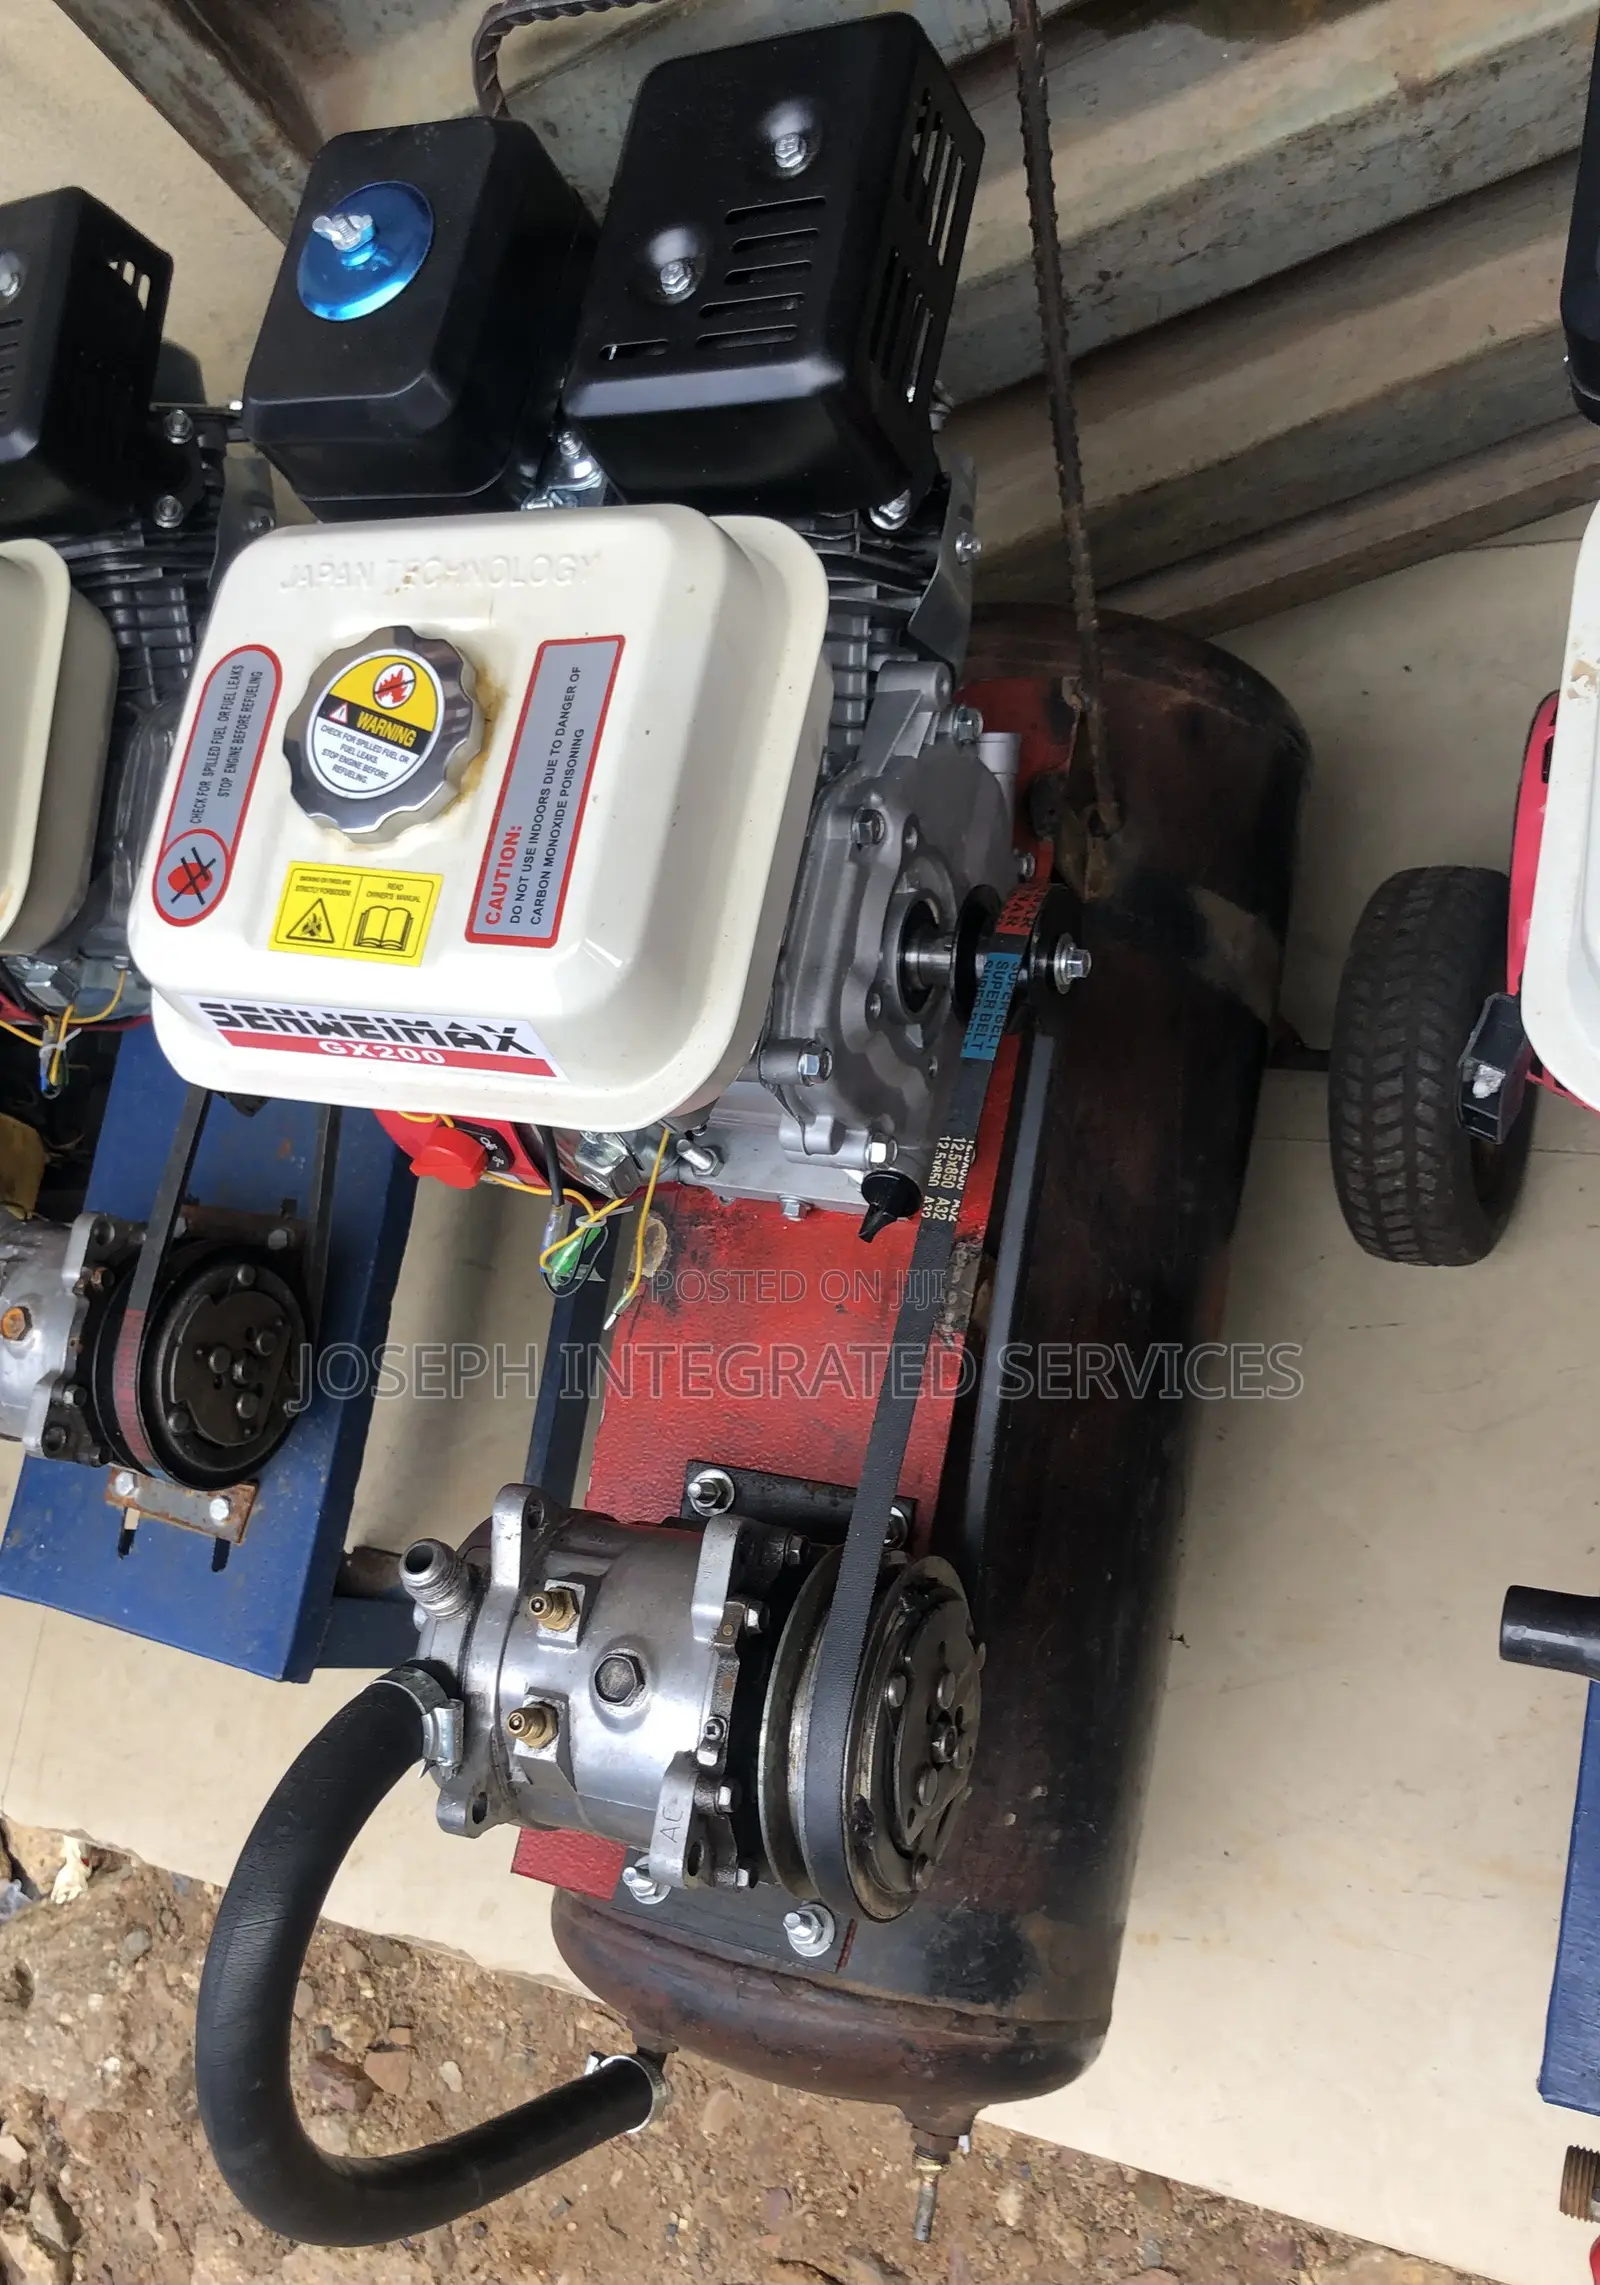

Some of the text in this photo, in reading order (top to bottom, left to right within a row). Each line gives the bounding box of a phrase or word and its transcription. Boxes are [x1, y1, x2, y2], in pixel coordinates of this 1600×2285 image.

[280, 560, 374, 592] JAPAN
[190, 664, 244, 824] CHECK FOR SPILLED FUEL OR FUEL LEAKS
[217, 671, 263, 798] STOP ENGINE BEFORE REFUELING
[321, 725, 410, 764] CHECK FOR SPILLED FUEL OR
[356, 711, 417, 748] WARNING
[321, 748, 389, 780] STOP ENGINE BEFORE
[340, 743, 356, 756] FUEL
[510, 667, 581, 923] DO NOT USE INDOORS DUE TO DANGER OF
[530, 729, 584, 925] CARBON MONOXIDE POISONING
[387, 882, 404, 891] READ
[485, 825, 522, 925] CAUTION:
[970, 961, 1009, 1051] SUPER BELT
[199, 1002, 536, 1055] SENWEIMAX
[318, 1039, 446, 1065] GX200
[932, 1197, 951, 1220] A32
